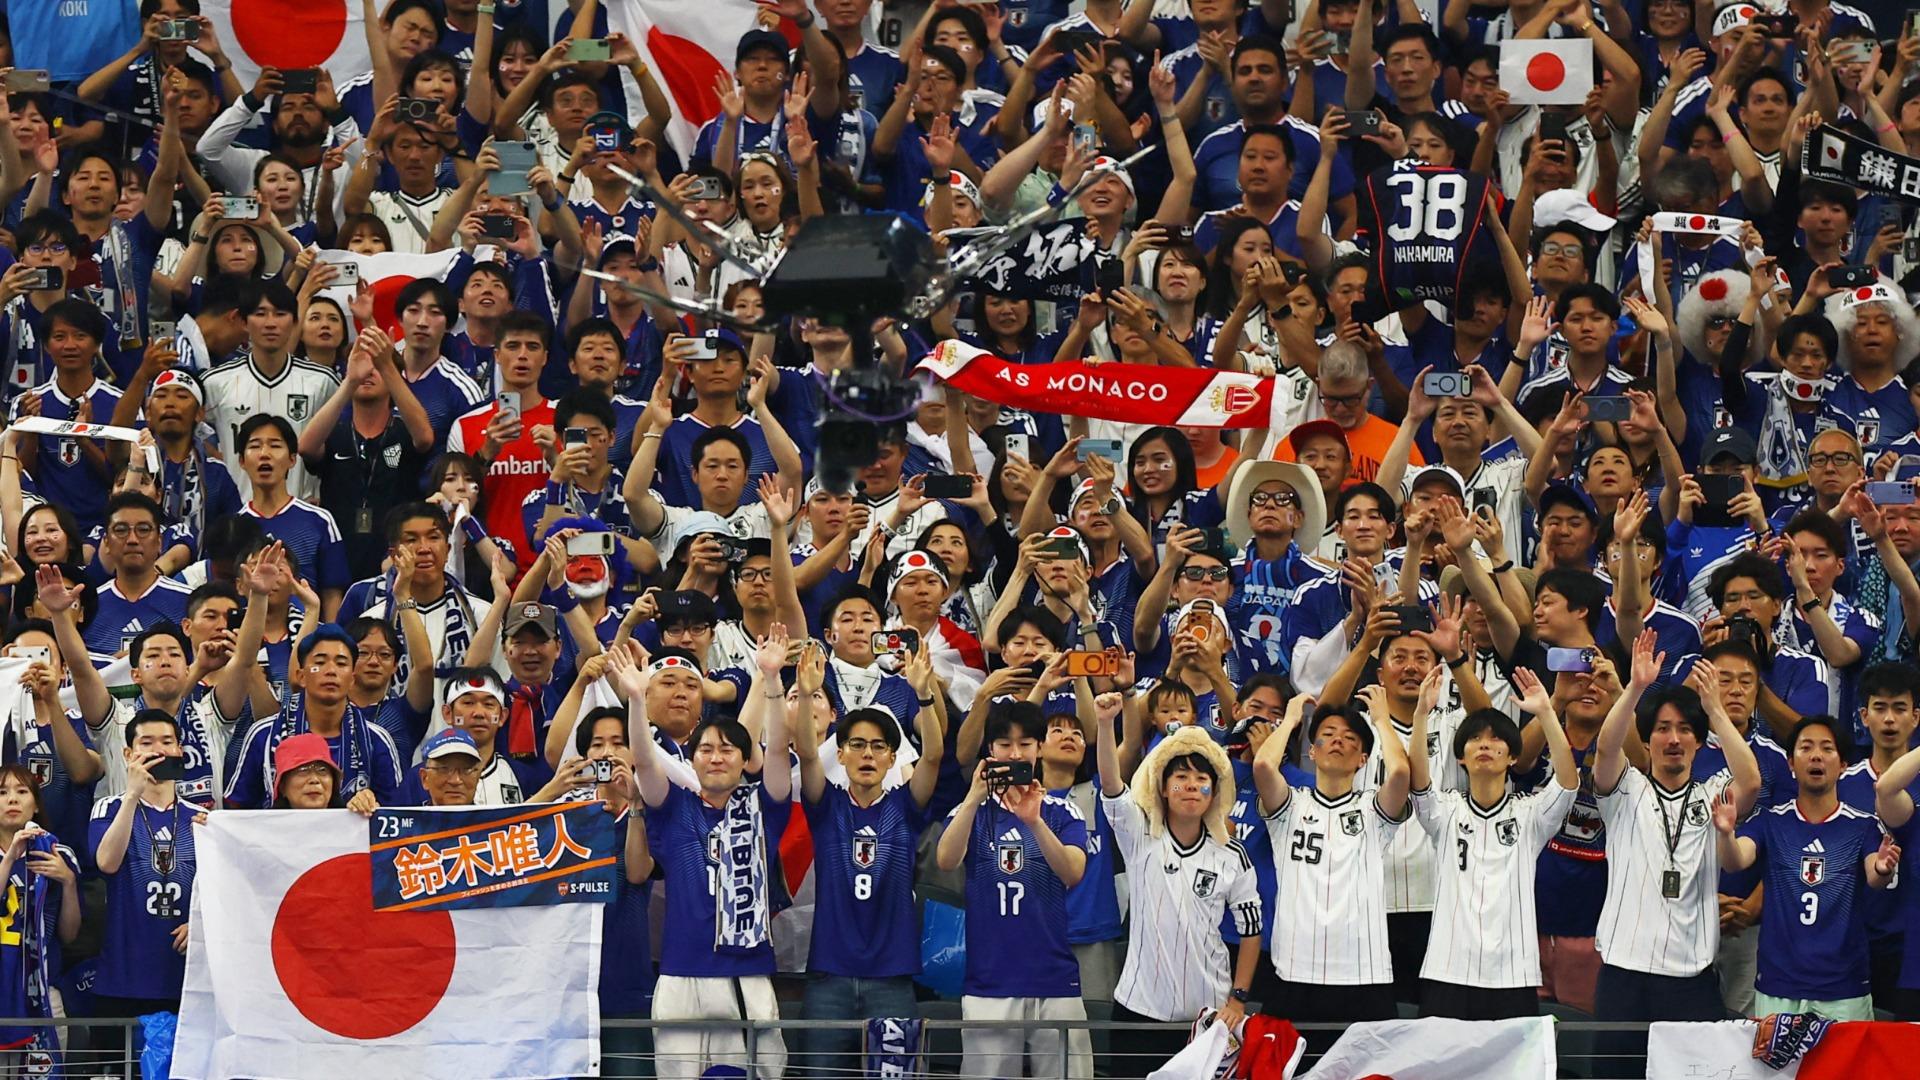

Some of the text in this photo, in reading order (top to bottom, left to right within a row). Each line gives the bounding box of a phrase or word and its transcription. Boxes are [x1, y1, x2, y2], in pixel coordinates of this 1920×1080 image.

[1386, 173, 1468, 242] 38
[1394, 246, 1455, 264] NAKAMURA
[995, 367, 1168, 402] AS MONACO
[487, 454, 554, 476] mbark
[1243, 594, 1293, 609] JAPAN
[378, 816, 414, 838] 23 MF
[393, 812, 592, 901] 鈴木唯人
[1291, 829, 1324, 865] 25
[1457, 838, 1469, 872] 3
[146, 881, 182, 916] 22
[570, 881, 609, 897] S-PULSE
[854, 873, 873, 900] 8
[997, 882, 1024, 916] 17
[1800, 892, 1819, 926] 3
